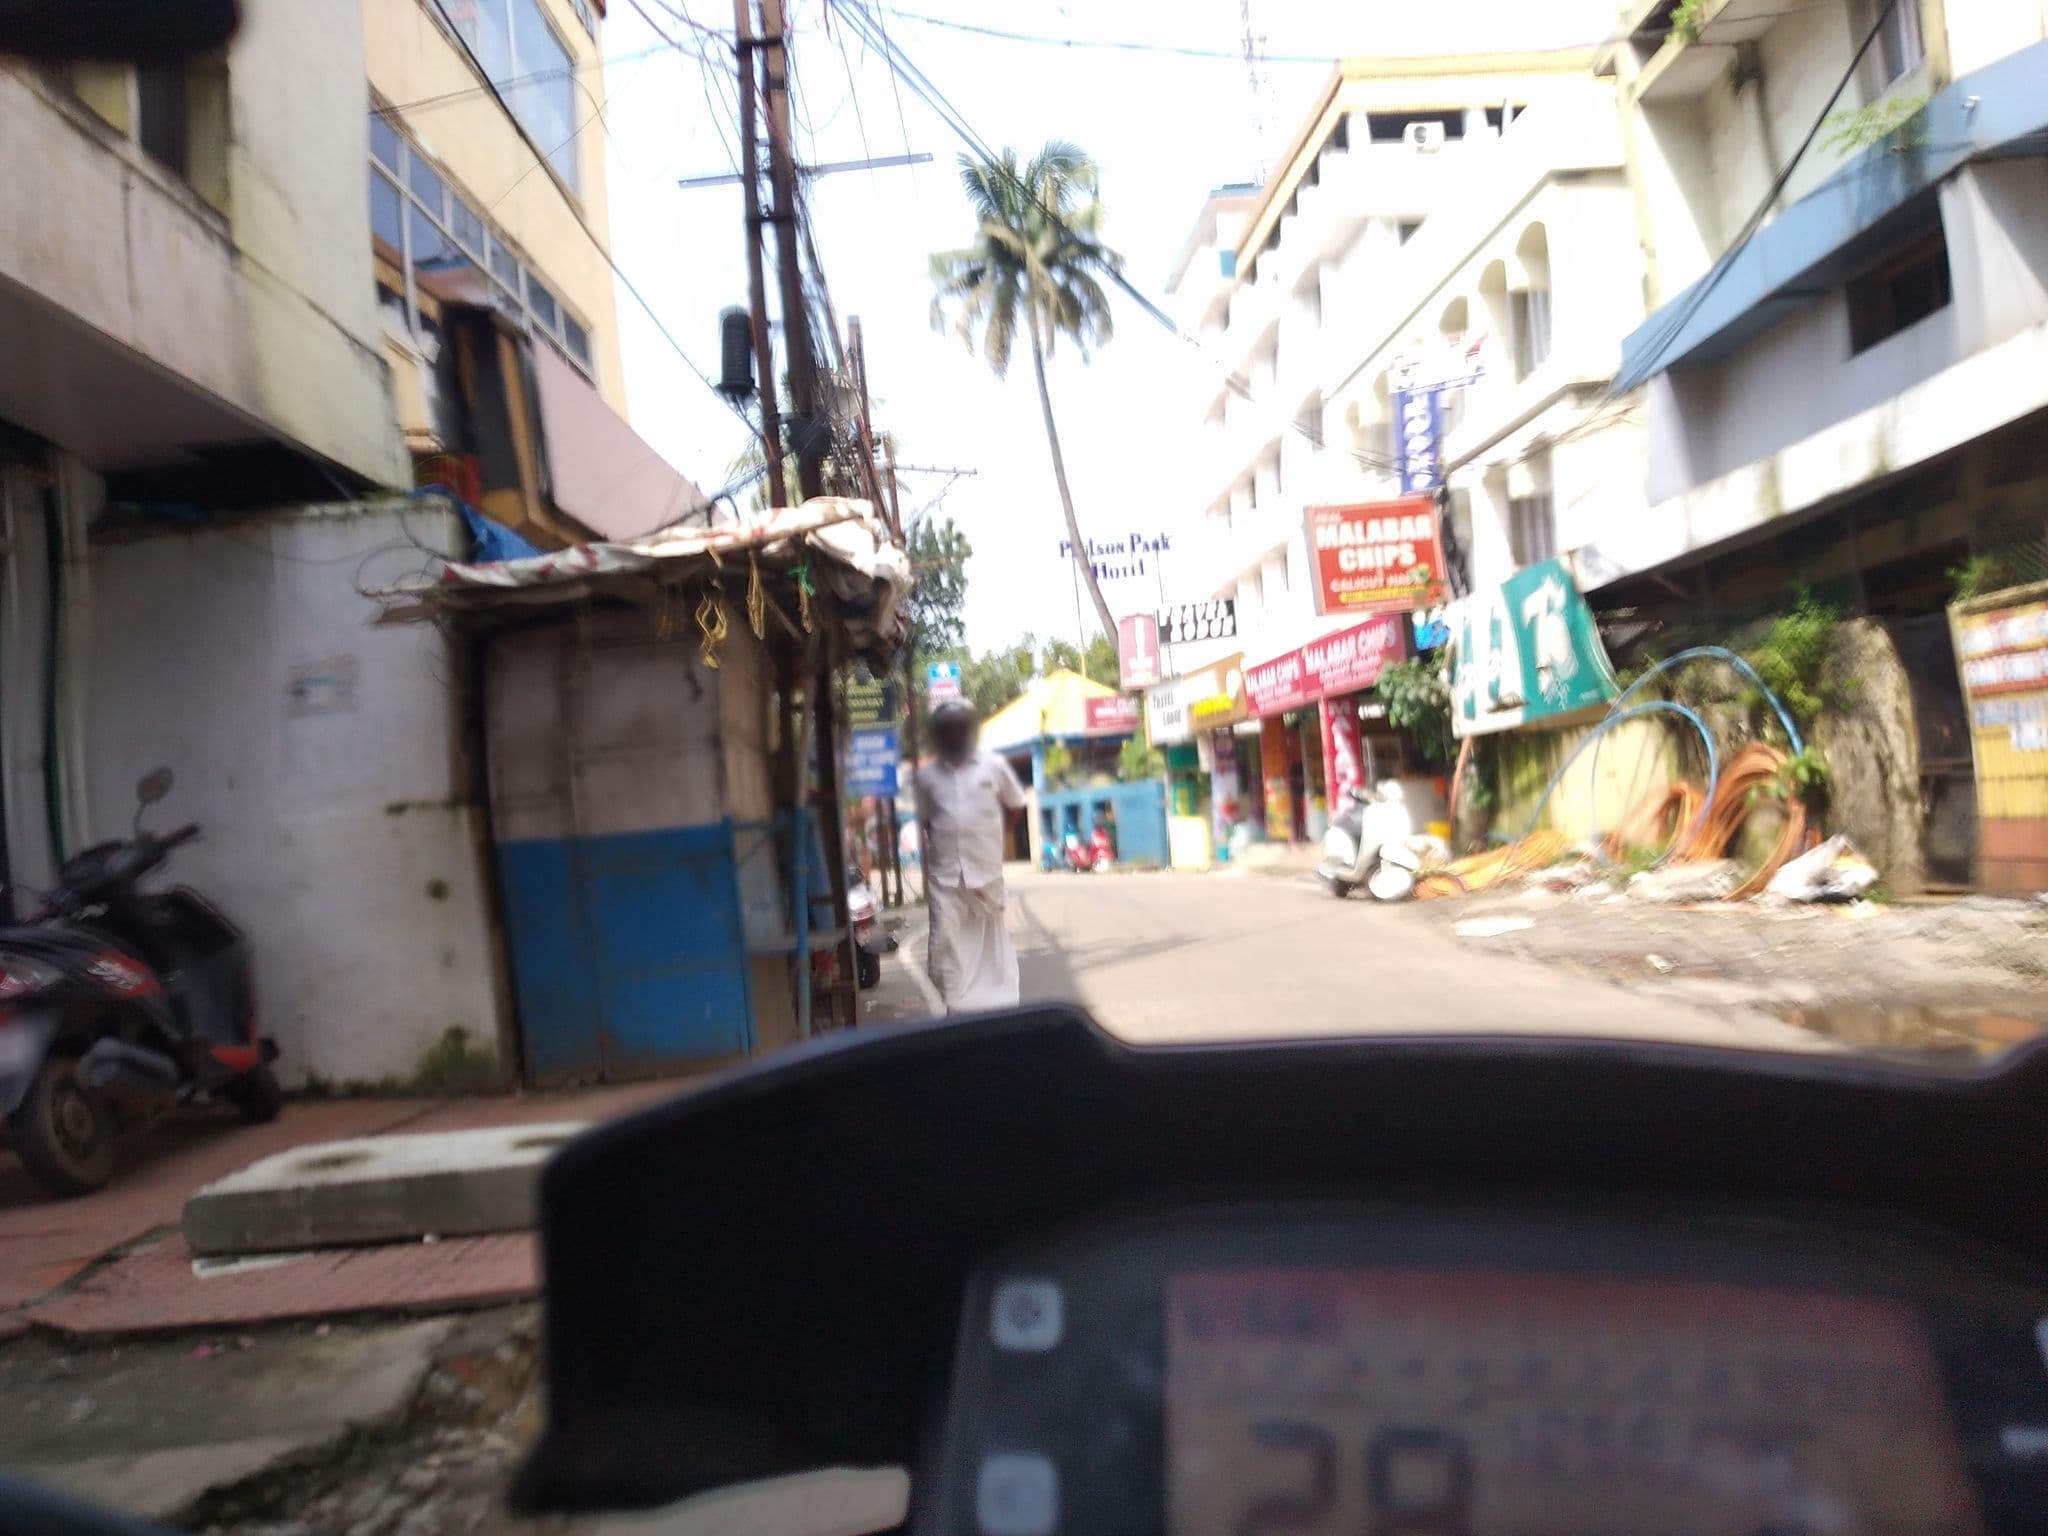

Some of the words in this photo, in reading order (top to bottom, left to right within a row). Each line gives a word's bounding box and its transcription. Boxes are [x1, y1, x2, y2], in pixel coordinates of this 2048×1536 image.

[1315, 514, 1433, 549] MALABAR
[1338, 543, 1417, 572] CHIPS
[1304, 632, 1357, 675] MALABAR
[1357, 619, 1396, 652] CHIPS
